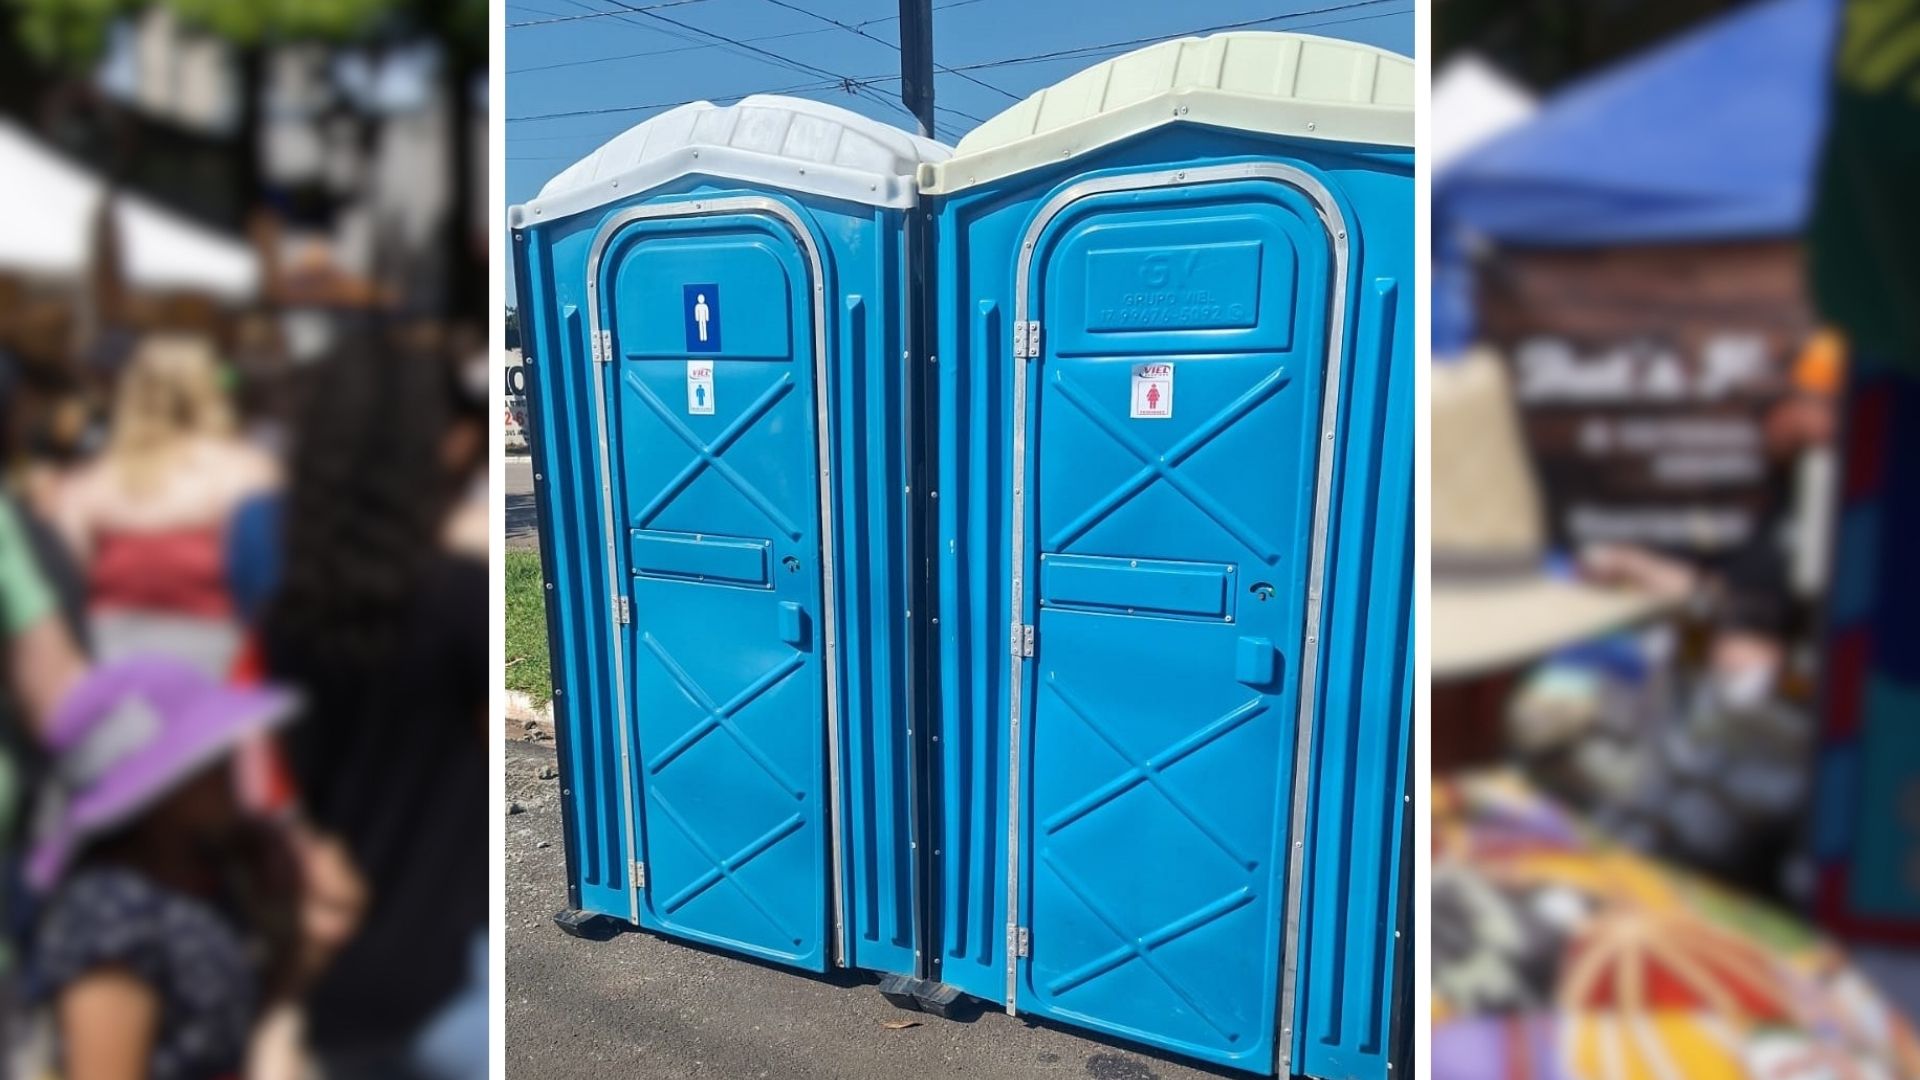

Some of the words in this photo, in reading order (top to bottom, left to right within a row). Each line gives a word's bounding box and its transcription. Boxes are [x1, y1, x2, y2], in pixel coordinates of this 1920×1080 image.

[1123, 292, 1175, 305] GRUPO
[1185, 290, 1215, 303] VIEL
[1144, 366, 1169, 374] VIEL
